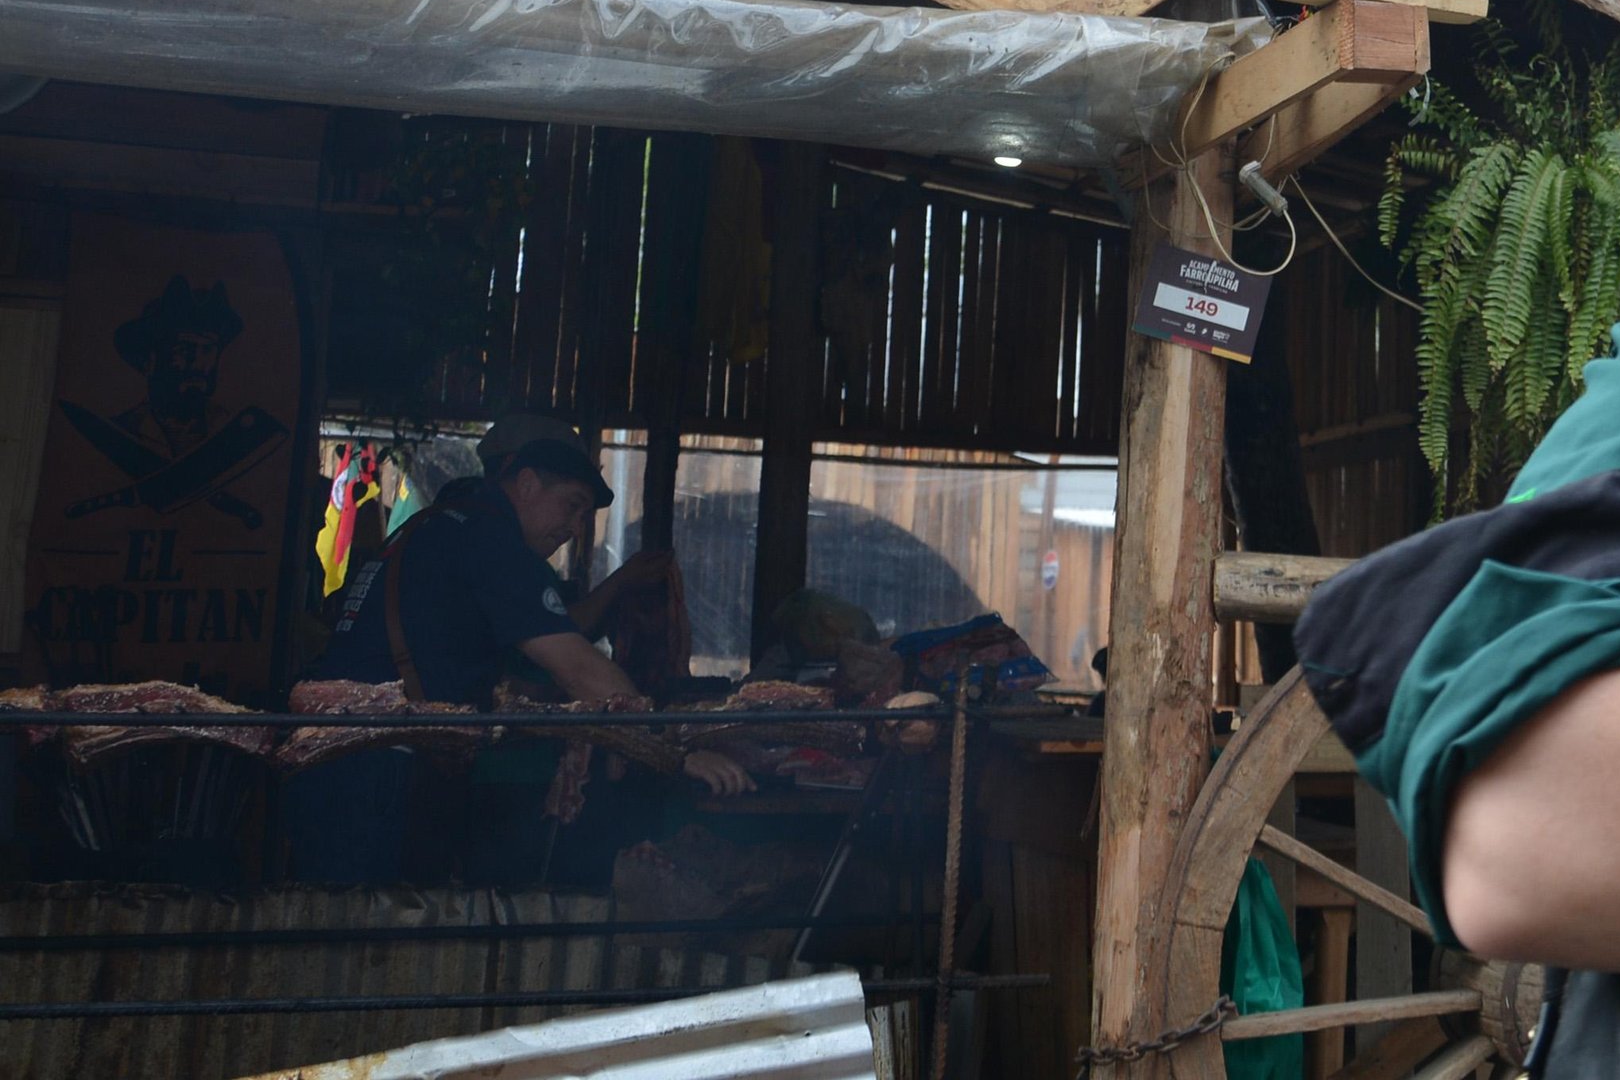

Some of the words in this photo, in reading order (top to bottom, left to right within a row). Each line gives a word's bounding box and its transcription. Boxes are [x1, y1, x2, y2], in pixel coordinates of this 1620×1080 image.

[1180, 264, 1239, 293] FARROUPILHA
[1185, 297, 1218, 317] 149
[122, 529, 184, 582] EL
[40, 587, 268, 643] CAPITAN
